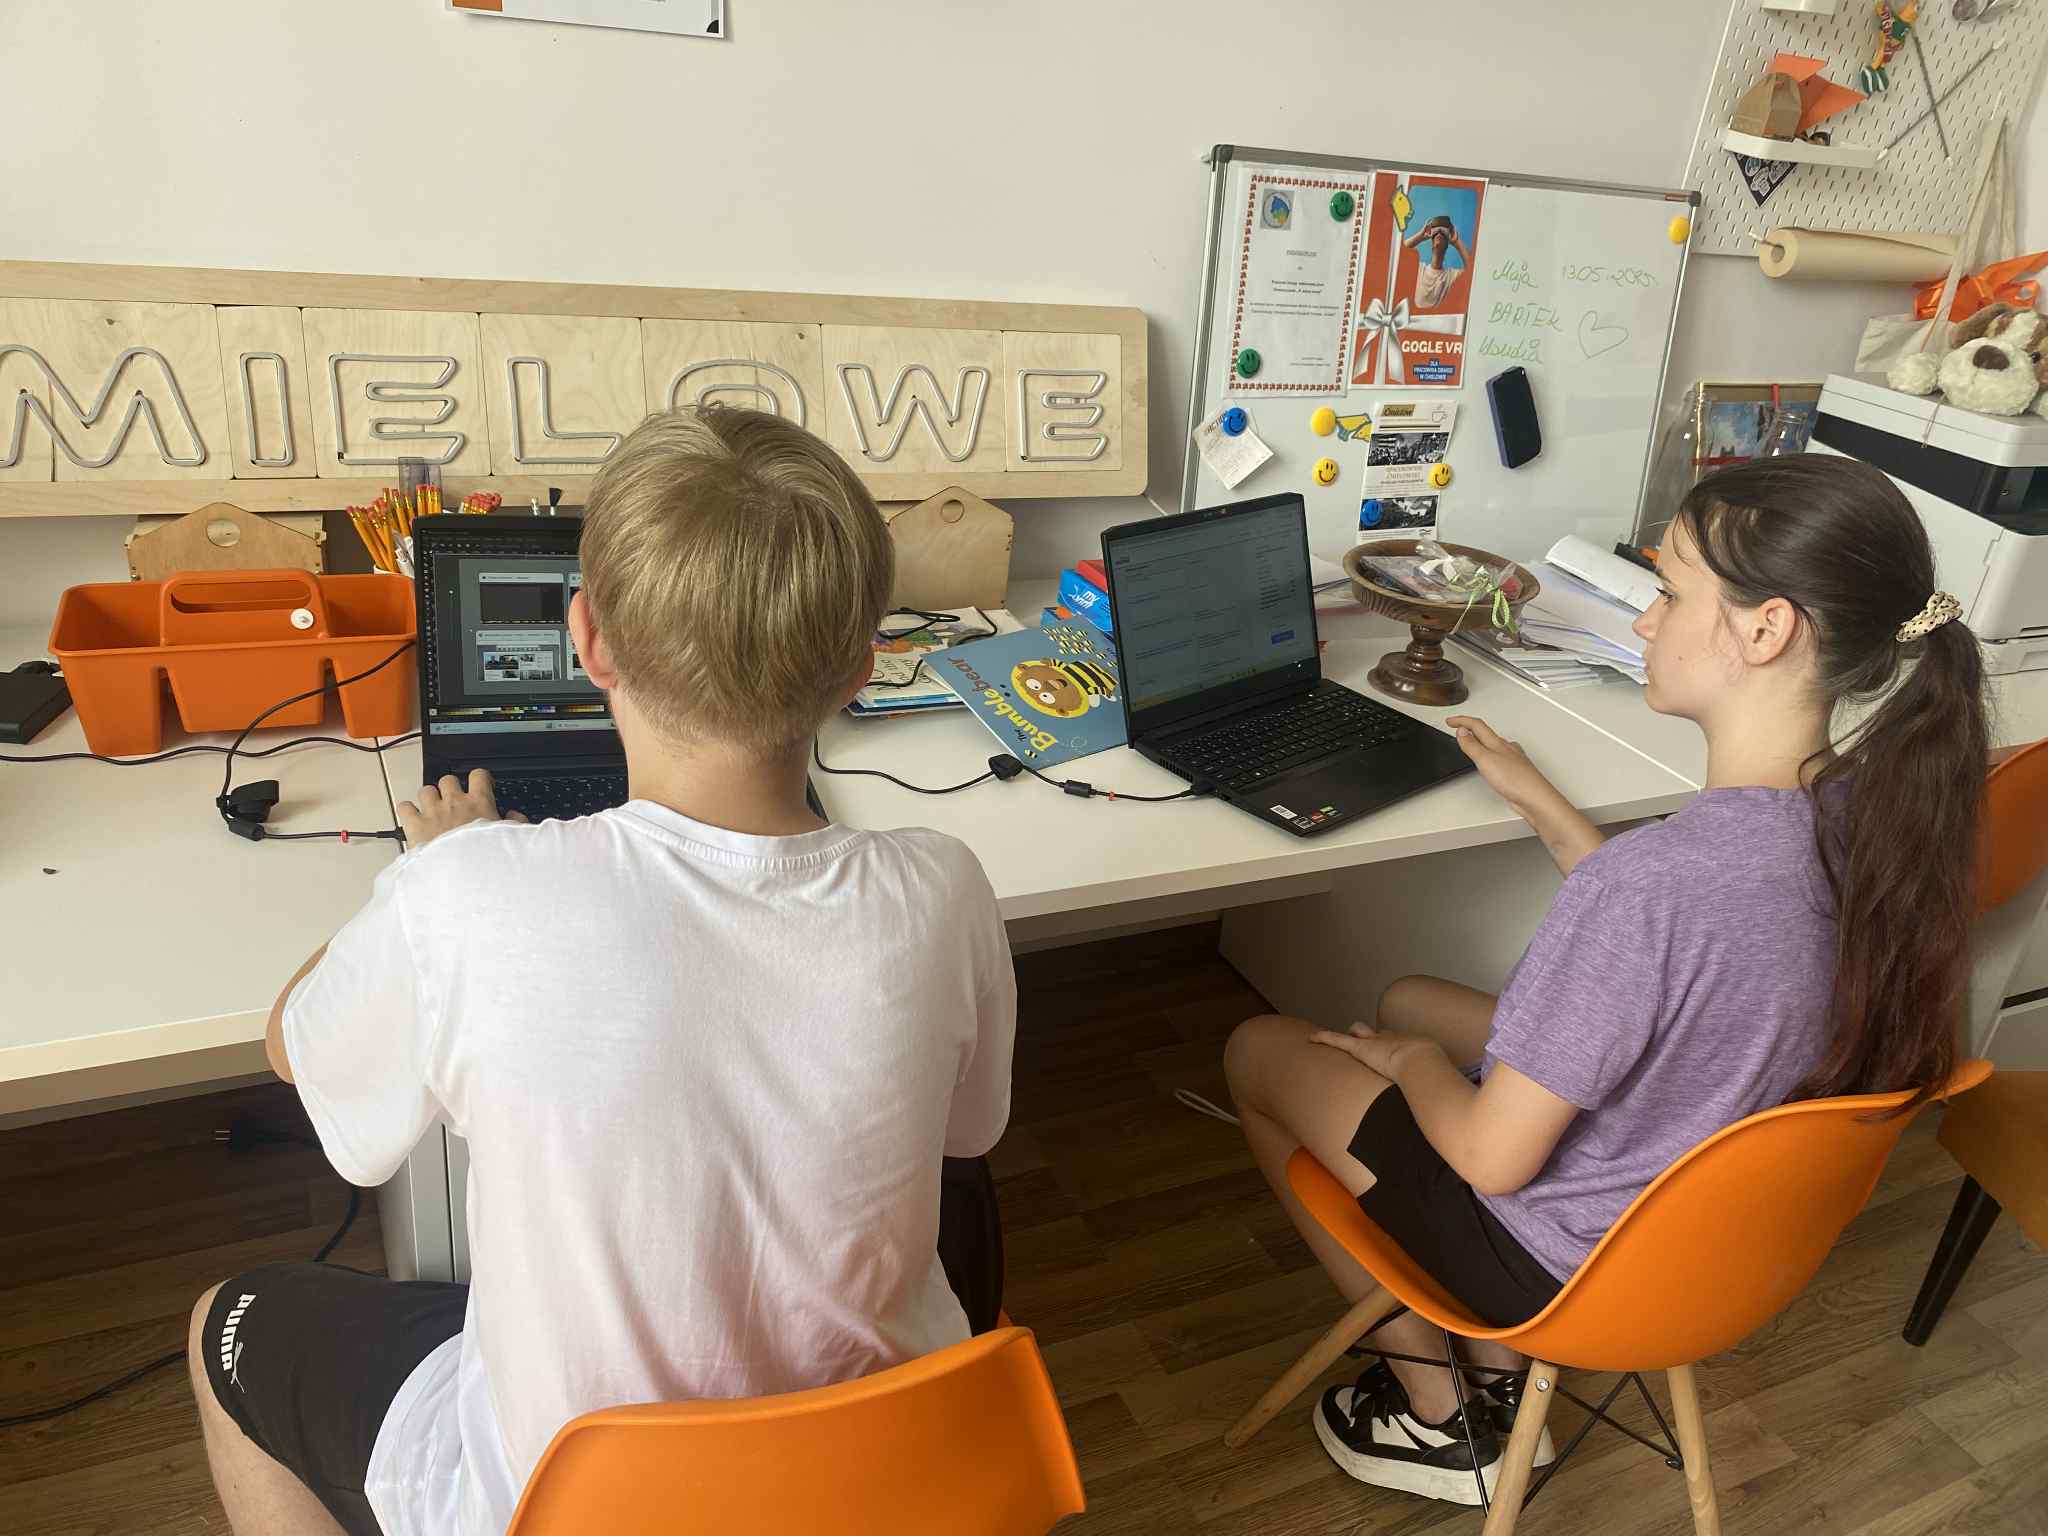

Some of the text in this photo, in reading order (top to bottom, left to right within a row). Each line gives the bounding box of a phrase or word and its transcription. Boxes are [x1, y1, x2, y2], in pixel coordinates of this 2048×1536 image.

[1401, 340, 1463, 355] GOGLE VR
[221, 1294, 256, 1371] PUMA
